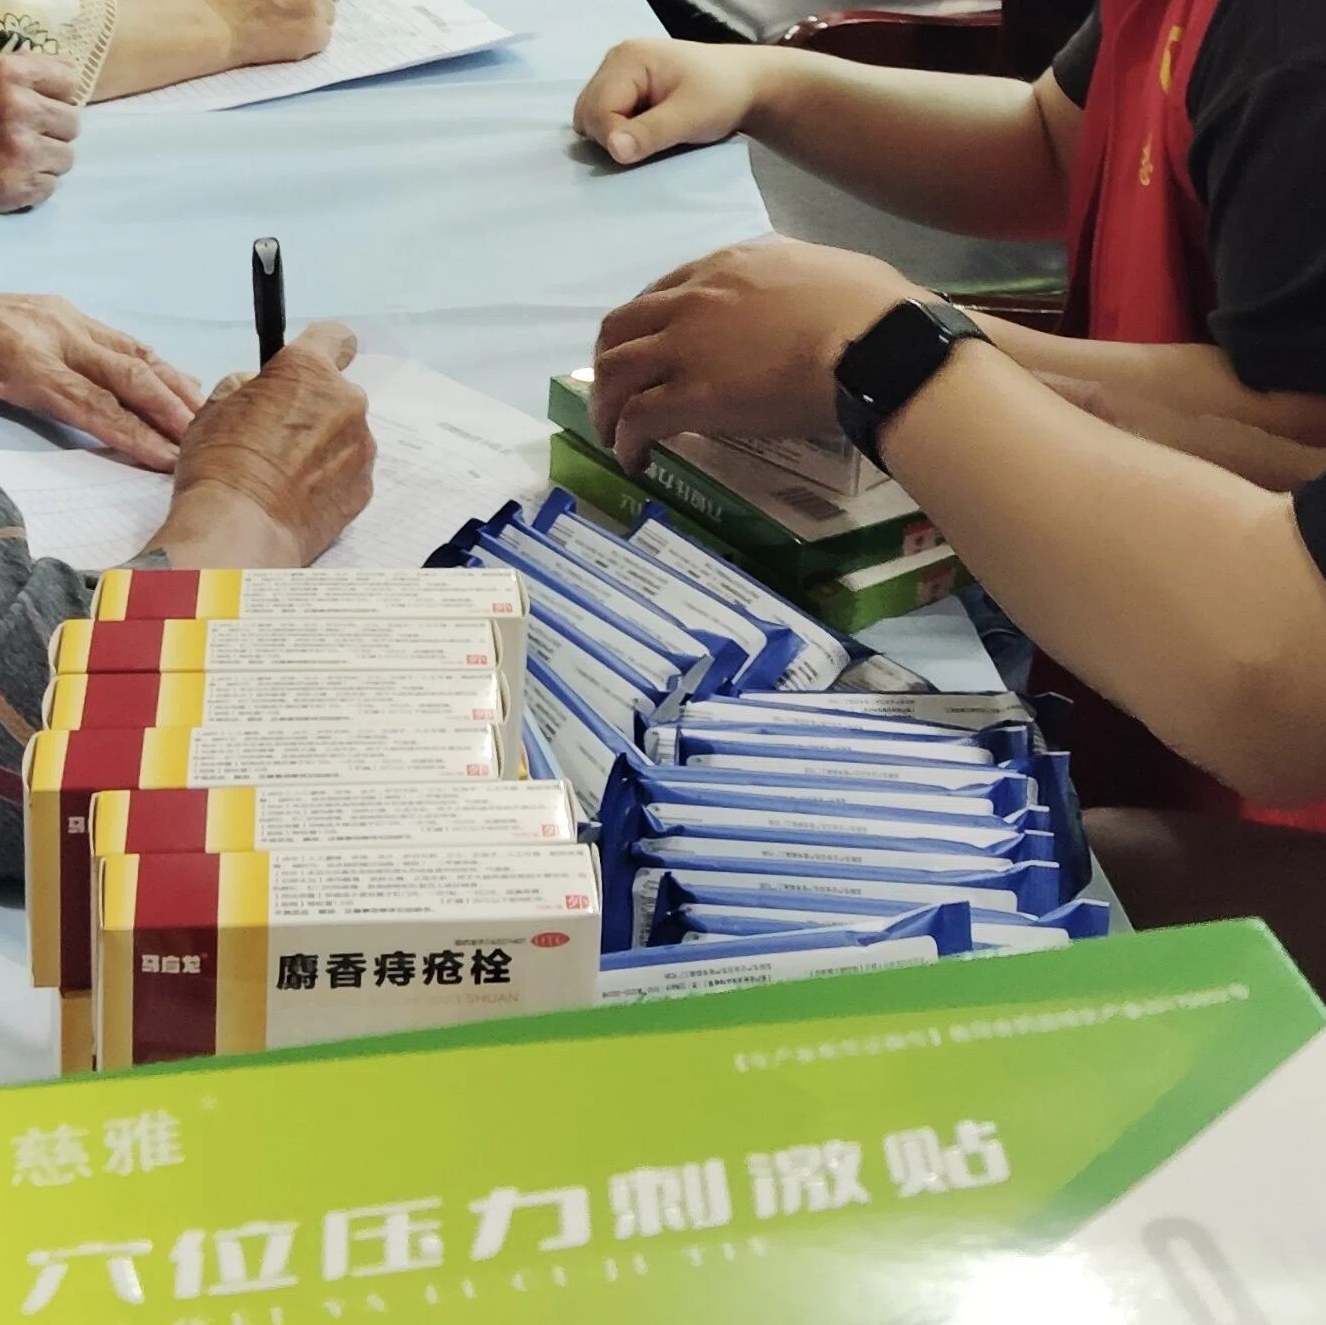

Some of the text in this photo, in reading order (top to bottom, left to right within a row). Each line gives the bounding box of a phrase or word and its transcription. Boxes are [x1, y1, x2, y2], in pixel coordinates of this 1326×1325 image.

[276, 949, 513, 990] 麝香痔疮栓
